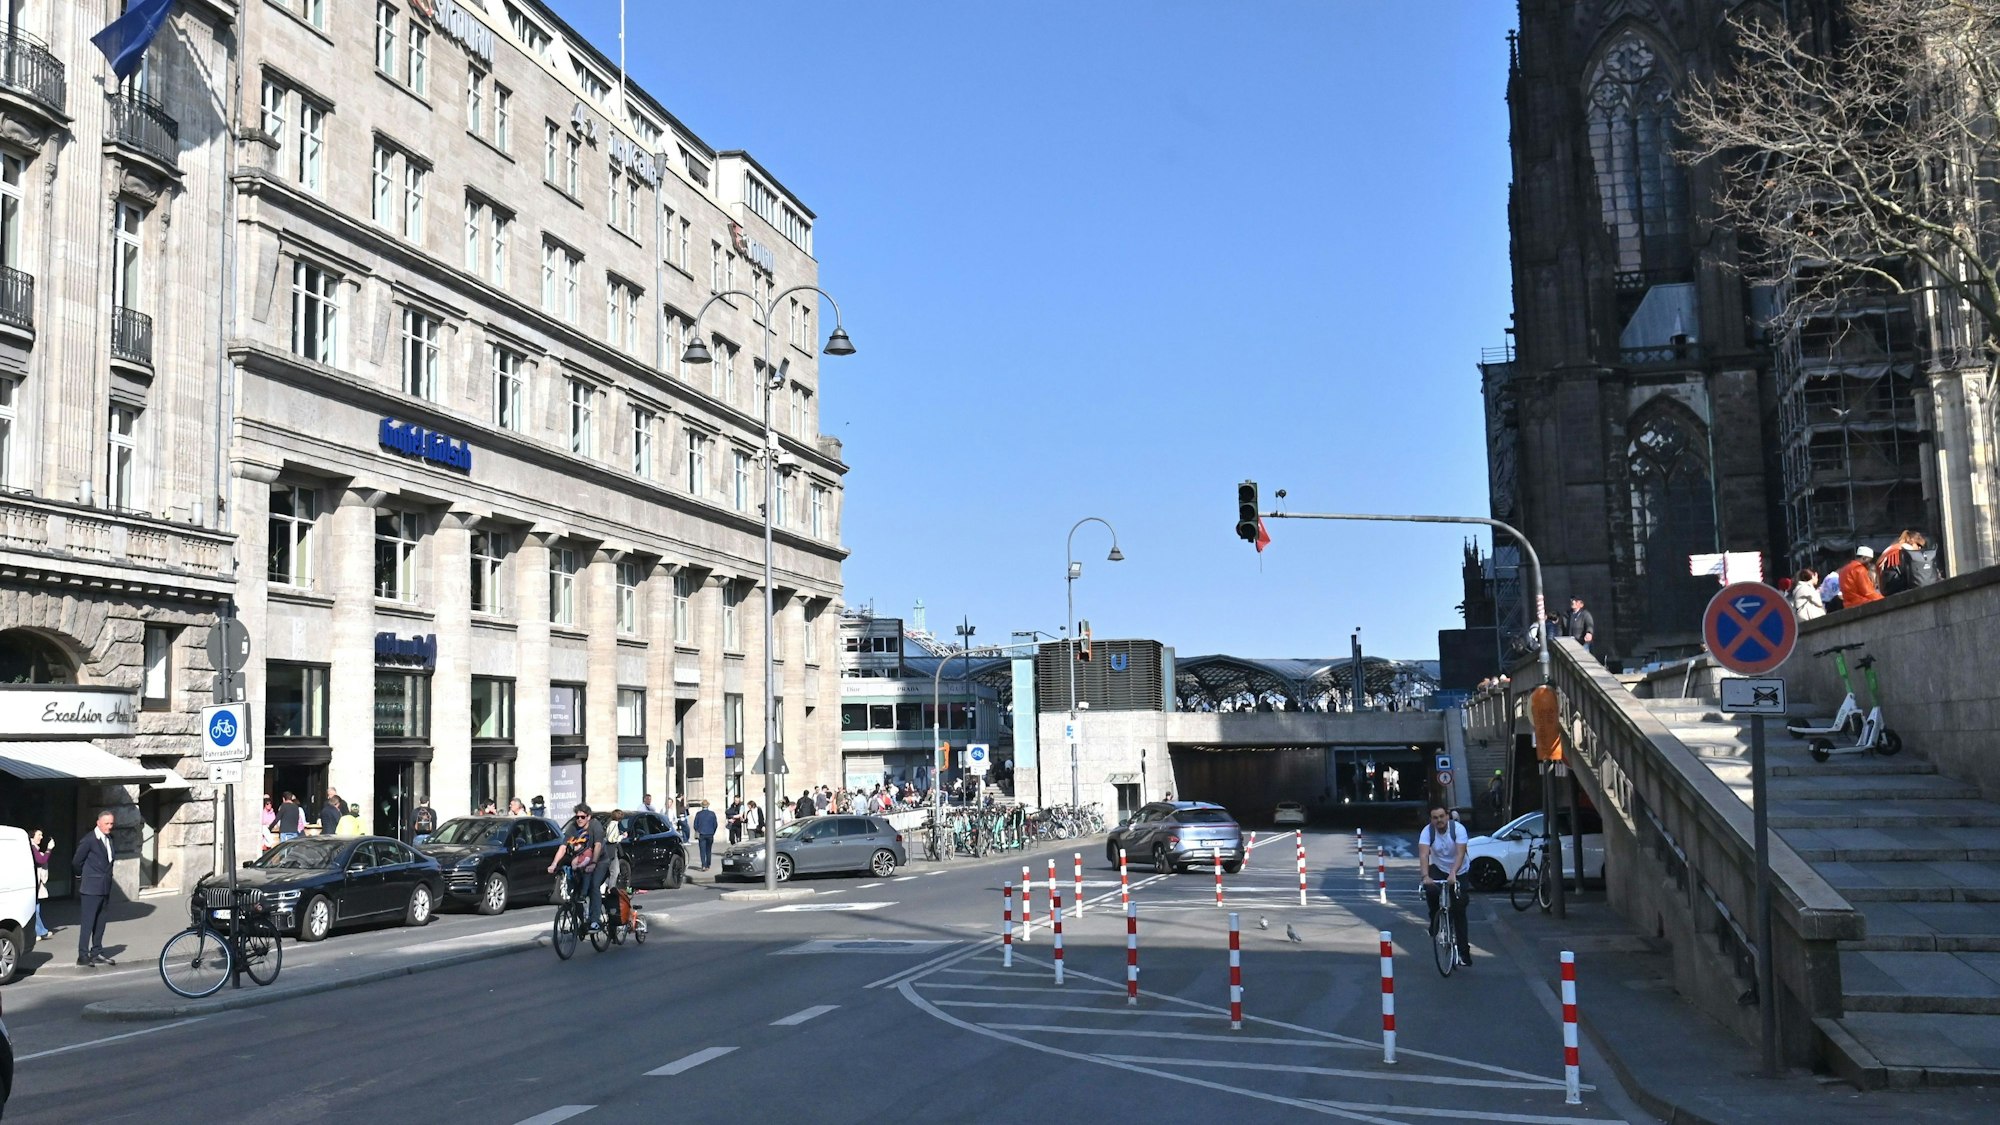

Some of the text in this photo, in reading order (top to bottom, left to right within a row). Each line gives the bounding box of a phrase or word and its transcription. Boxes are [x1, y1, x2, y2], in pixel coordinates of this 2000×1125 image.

[571, 102, 585, 133] 4
[1111, 653, 1128, 673] U
[41, 701, 102, 724] Excelsior
[204, 748, 244, 758] Fahrradstraße
